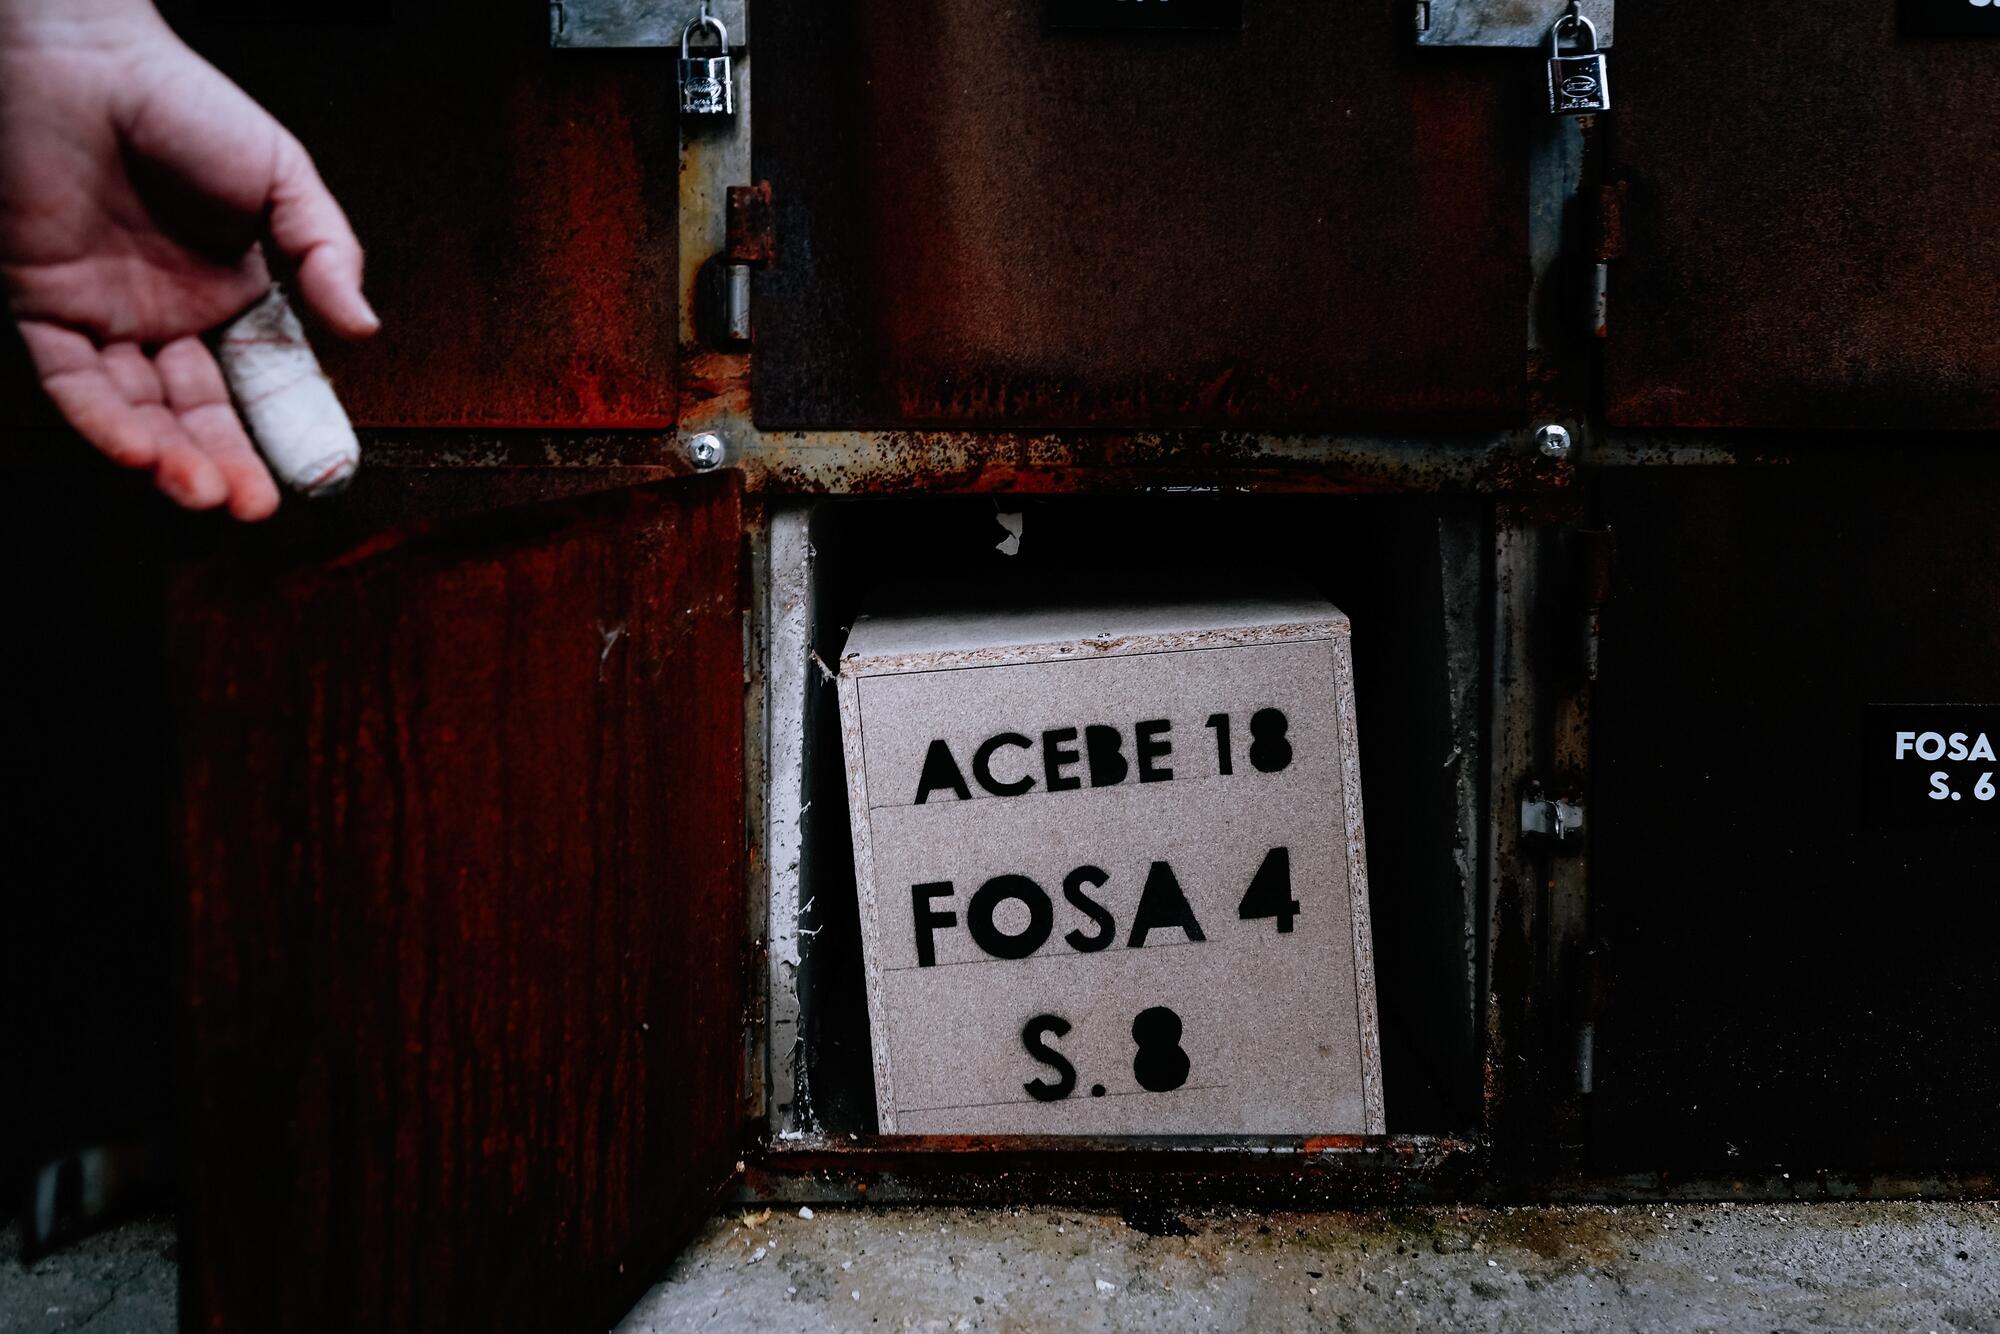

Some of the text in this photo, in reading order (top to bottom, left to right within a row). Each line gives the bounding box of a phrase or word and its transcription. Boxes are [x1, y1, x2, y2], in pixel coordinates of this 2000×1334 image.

[914, 707, 1293, 805] ACEBE 18
[1895, 731, 1998, 762] FOSA
[911, 847, 1300, 967] FOSA 4
